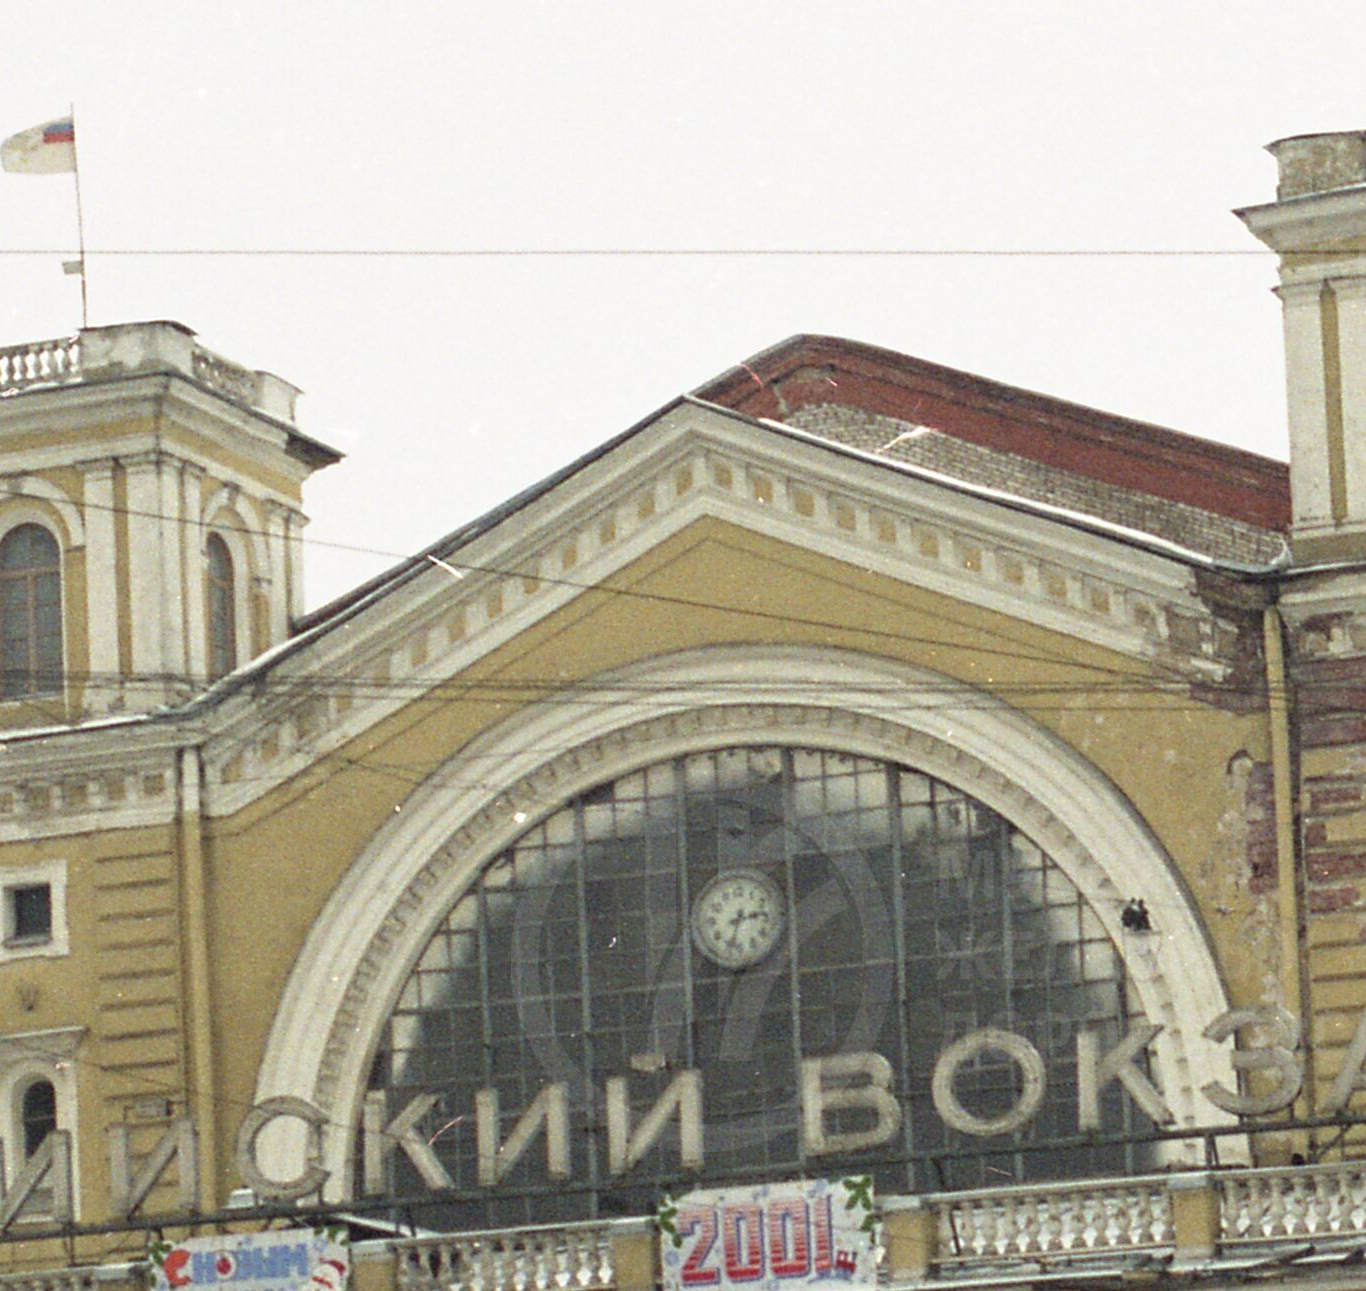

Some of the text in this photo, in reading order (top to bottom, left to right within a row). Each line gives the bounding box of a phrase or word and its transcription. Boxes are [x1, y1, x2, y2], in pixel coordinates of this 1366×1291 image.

[163, 1243, 309, 1287] С НОВЫМ
[677, 1194, 833, 1287] 2001
